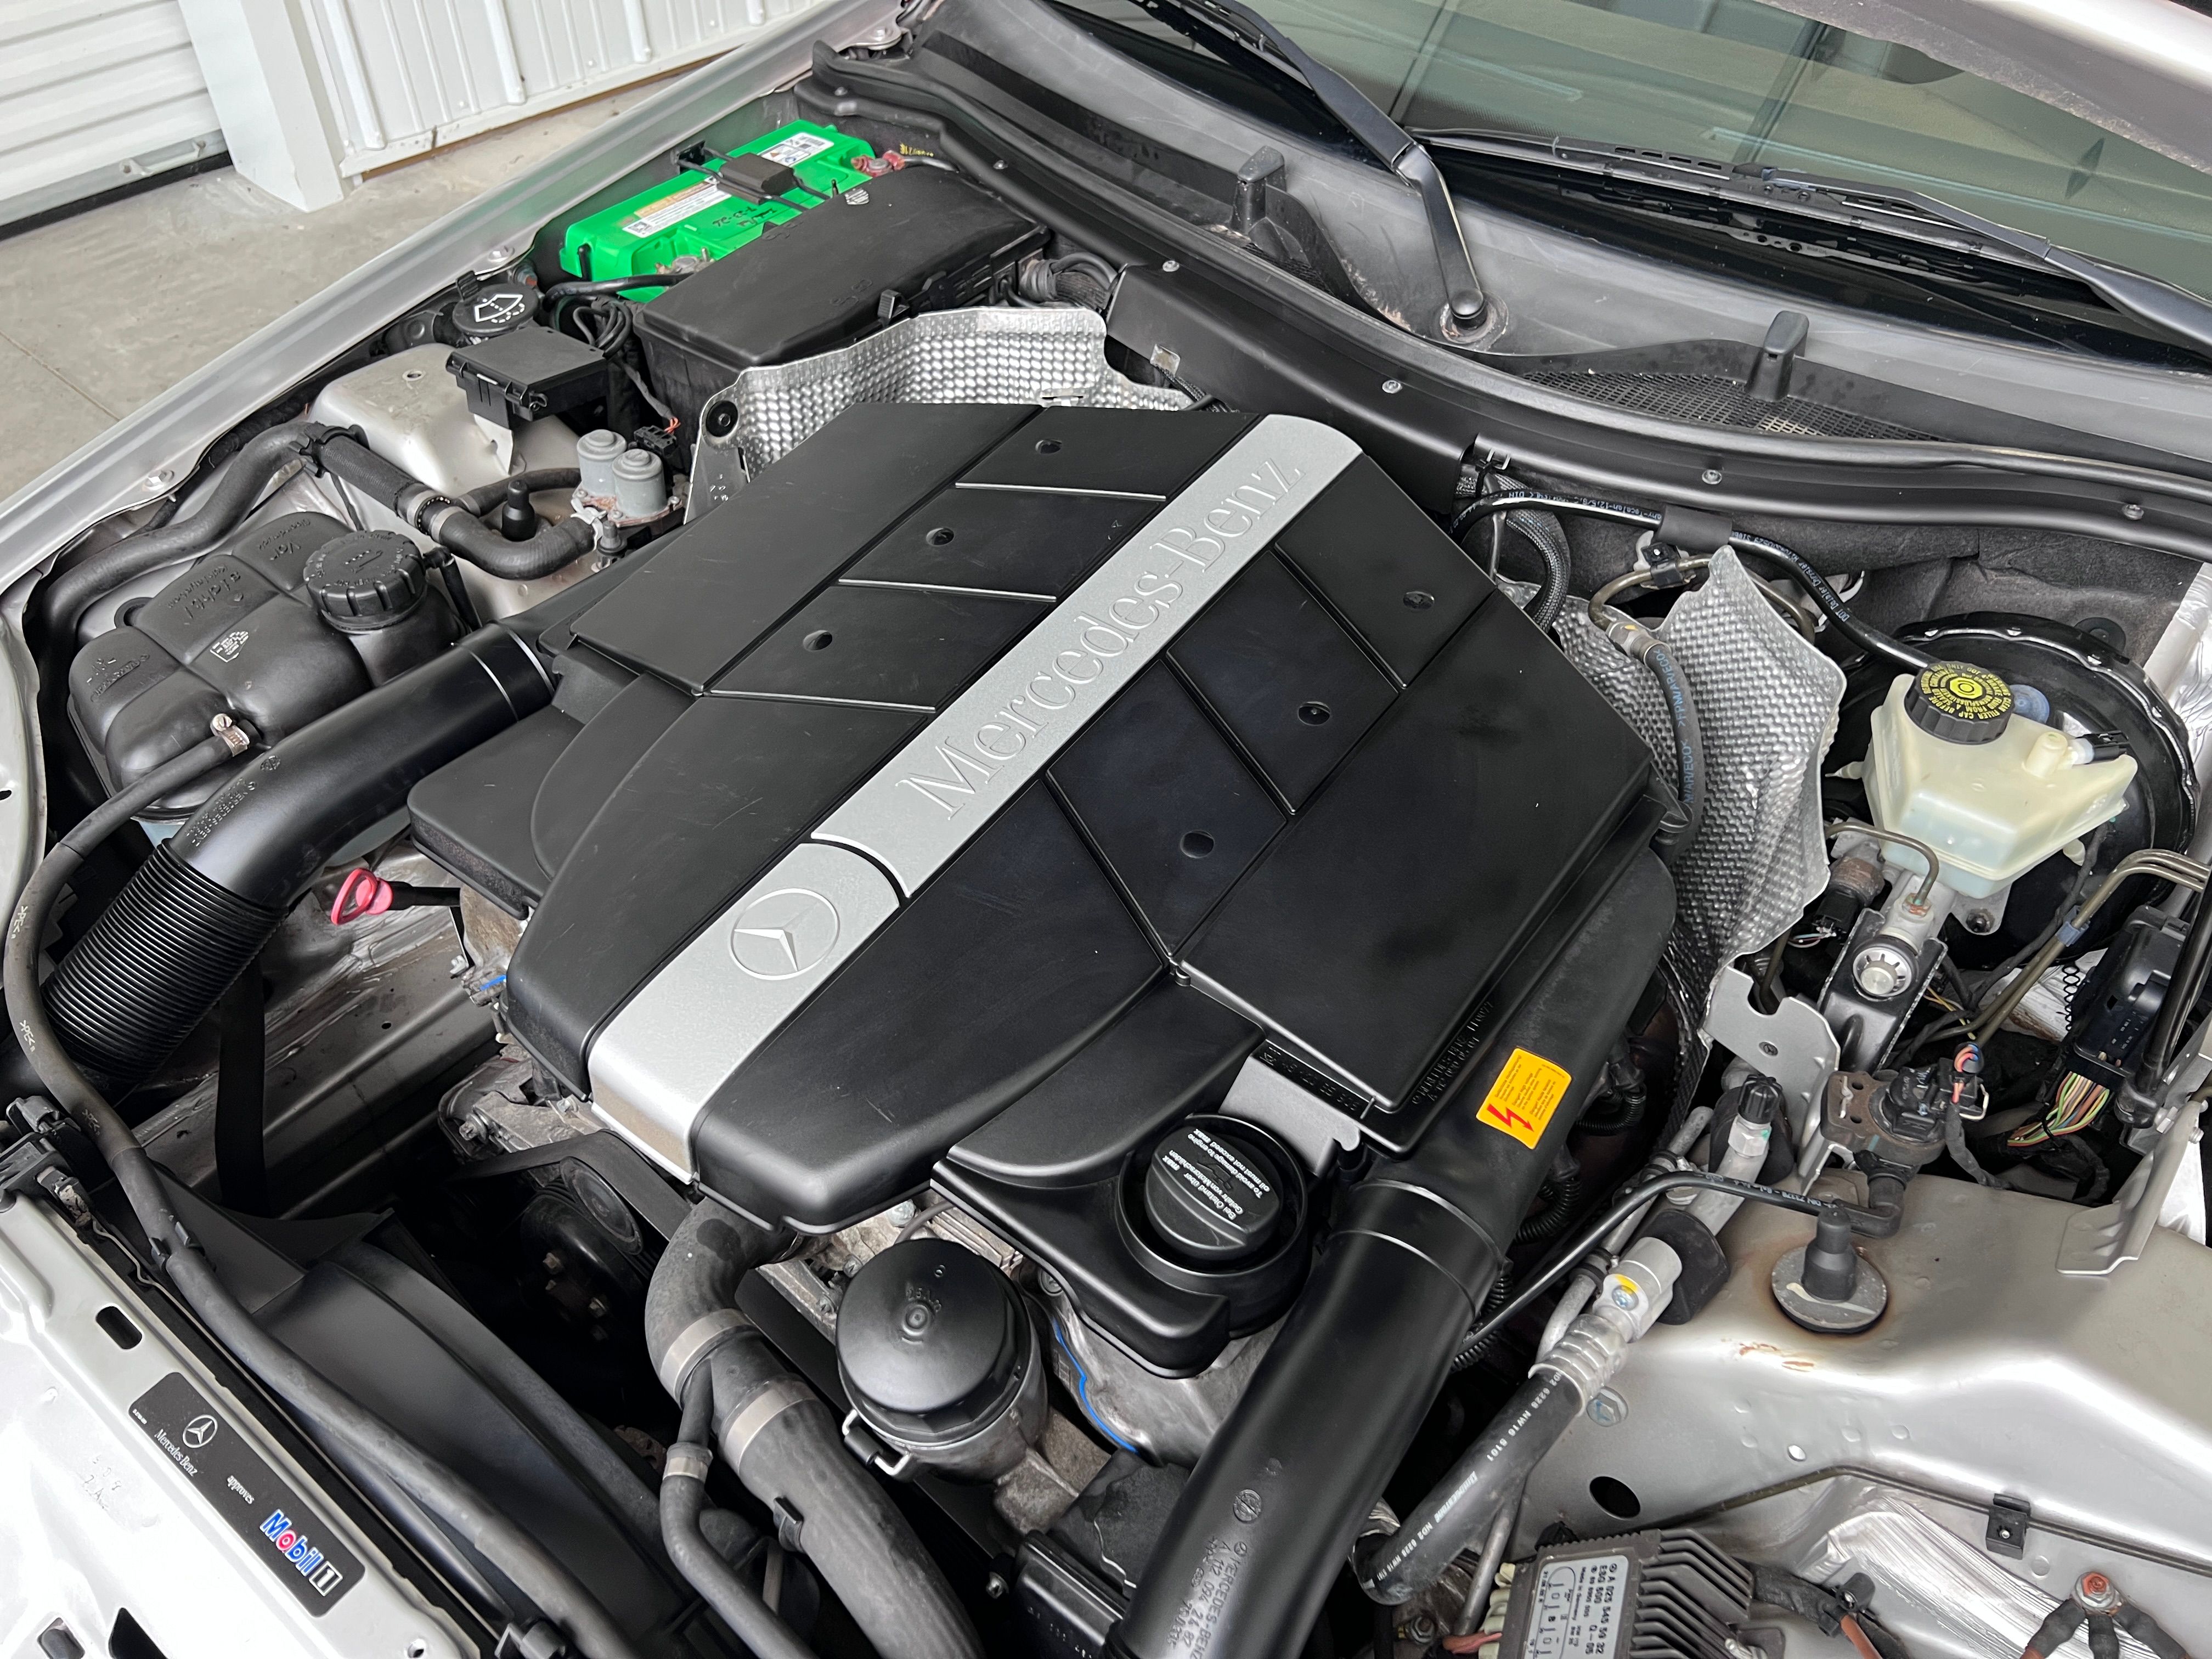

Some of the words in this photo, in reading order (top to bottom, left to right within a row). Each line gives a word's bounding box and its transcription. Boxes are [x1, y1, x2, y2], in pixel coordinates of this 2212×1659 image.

[896, 458, 1306, 821] Mercedes-Benz
[1187, 1131, 1210, 1152] engine
[1206, 1148, 1216, 1157] to
[1209, 1140, 1235, 1163] exceed
[1167, 1149, 1212, 1187] Motorschäden
[1212, 1152, 1239, 1176] damage
[1233, 1159, 1246, 1172] not
[1182, 1171, 1200, 1188] über
[1235, 1171, 1255, 1189] avoid
[1243, 1167, 1262, 1184] must
[1209, 1182, 1223, 1195] von
[1251, 1186, 1265, 1199] To
[1259, 1181, 1271, 1193] oil
[1219, 1192, 1245, 1215] Gefahr
[1221, 1205, 1237, 1221] Bei
[1507, 1409, 1532, 1437] NW16
[227, 1475, 255, 1505] approves
[259, 1509, 323, 1579] Mobil
